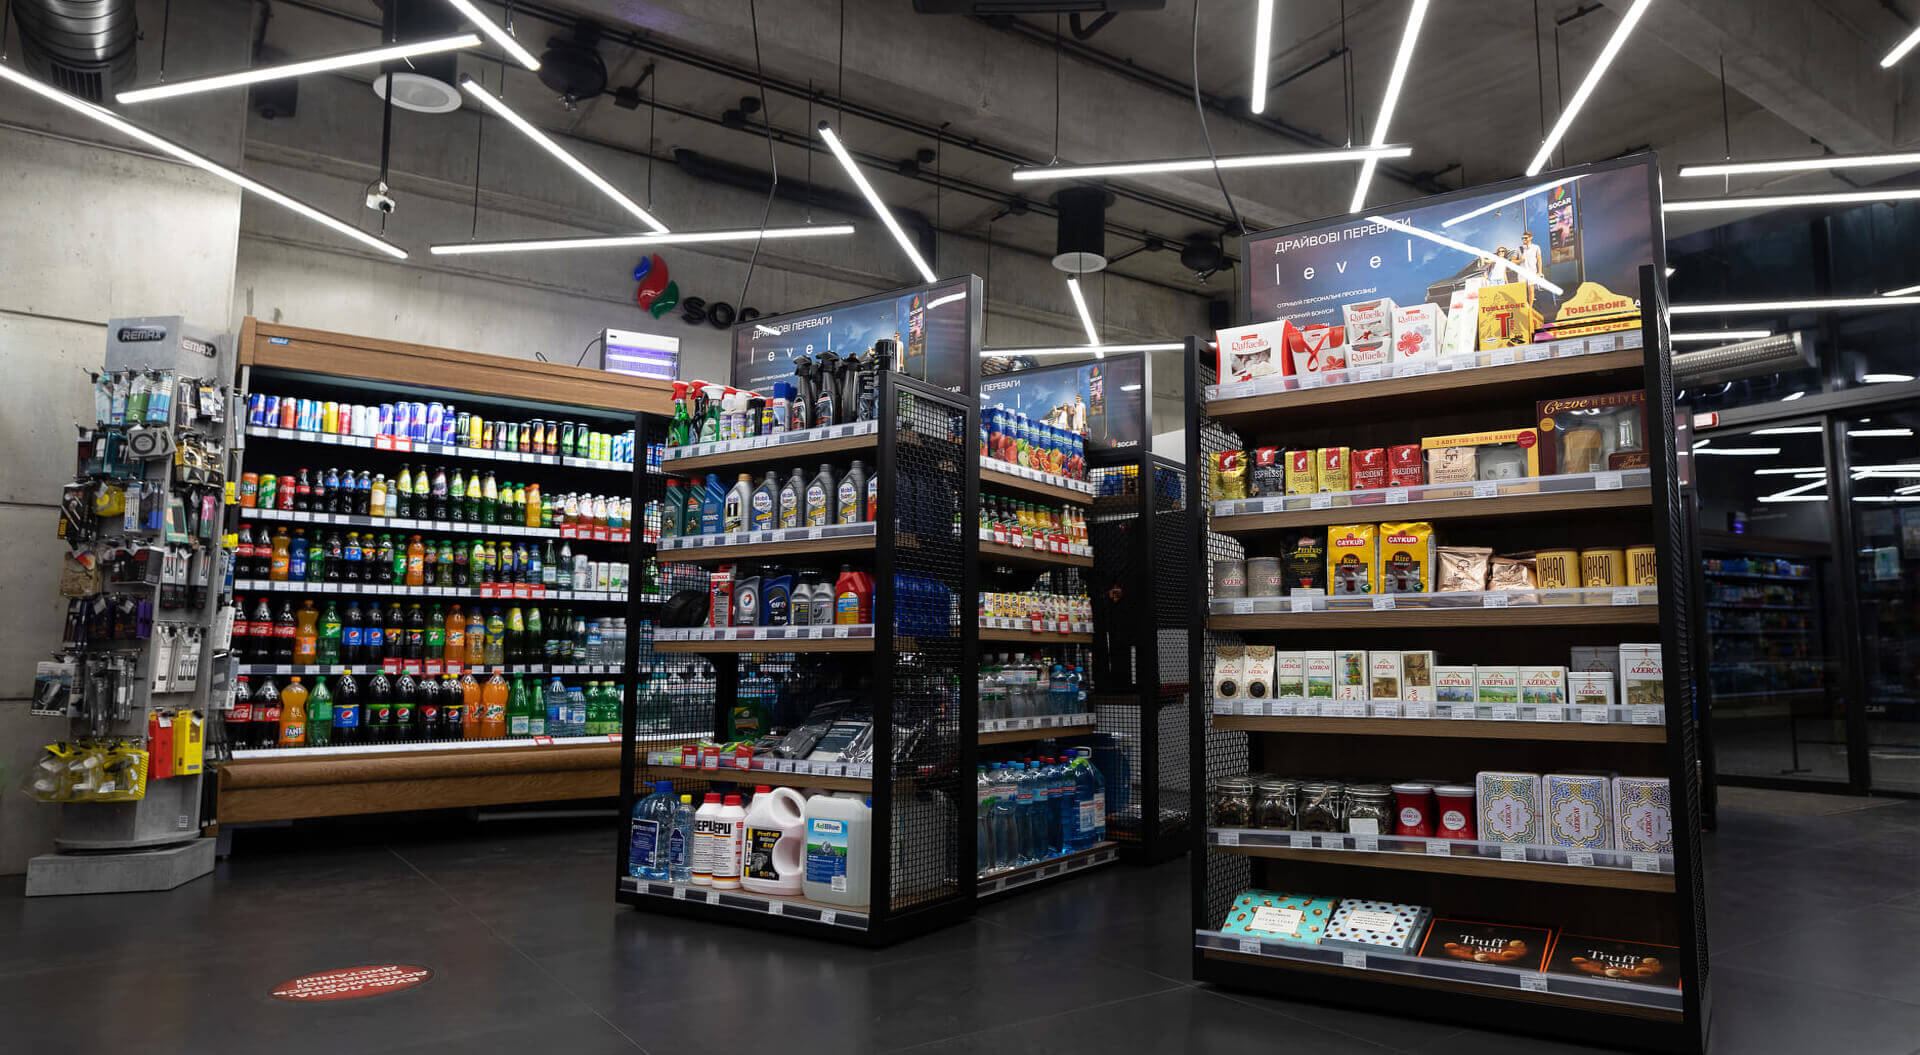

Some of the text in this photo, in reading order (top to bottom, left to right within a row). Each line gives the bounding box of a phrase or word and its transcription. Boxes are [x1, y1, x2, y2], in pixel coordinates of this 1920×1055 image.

[1275, 233, 1340, 255] ДРАЙВОВІ
[1481, 302, 1525, 313] TOBLERONE
[1565, 299, 1627, 316] TOBLERONE
[1350, 310, 1385, 323] Raffaello
[1398, 313, 1430, 324] Raffaello
[792, 315, 833, 332] ПЕРЕВАГИ
[1552, 322, 1631, 337] TOBLERONE
[122, 329, 162, 341] REMAX
[1231, 338, 1269, 352] Raffaello
[1351, 350, 1387, 362] Raffaello
[984, 379, 1021, 392] ПЕРЕВАГИ
[1117, 440, 1138, 448] SOCAR
[1439, 678, 1471, 686] АЗЕРЧАЙ
[1481, 678, 1515, 686] АЗЕРЧАЙ
[1460, 934, 1507, 948] Truff
[1588, 949, 1640, 965] Truff
